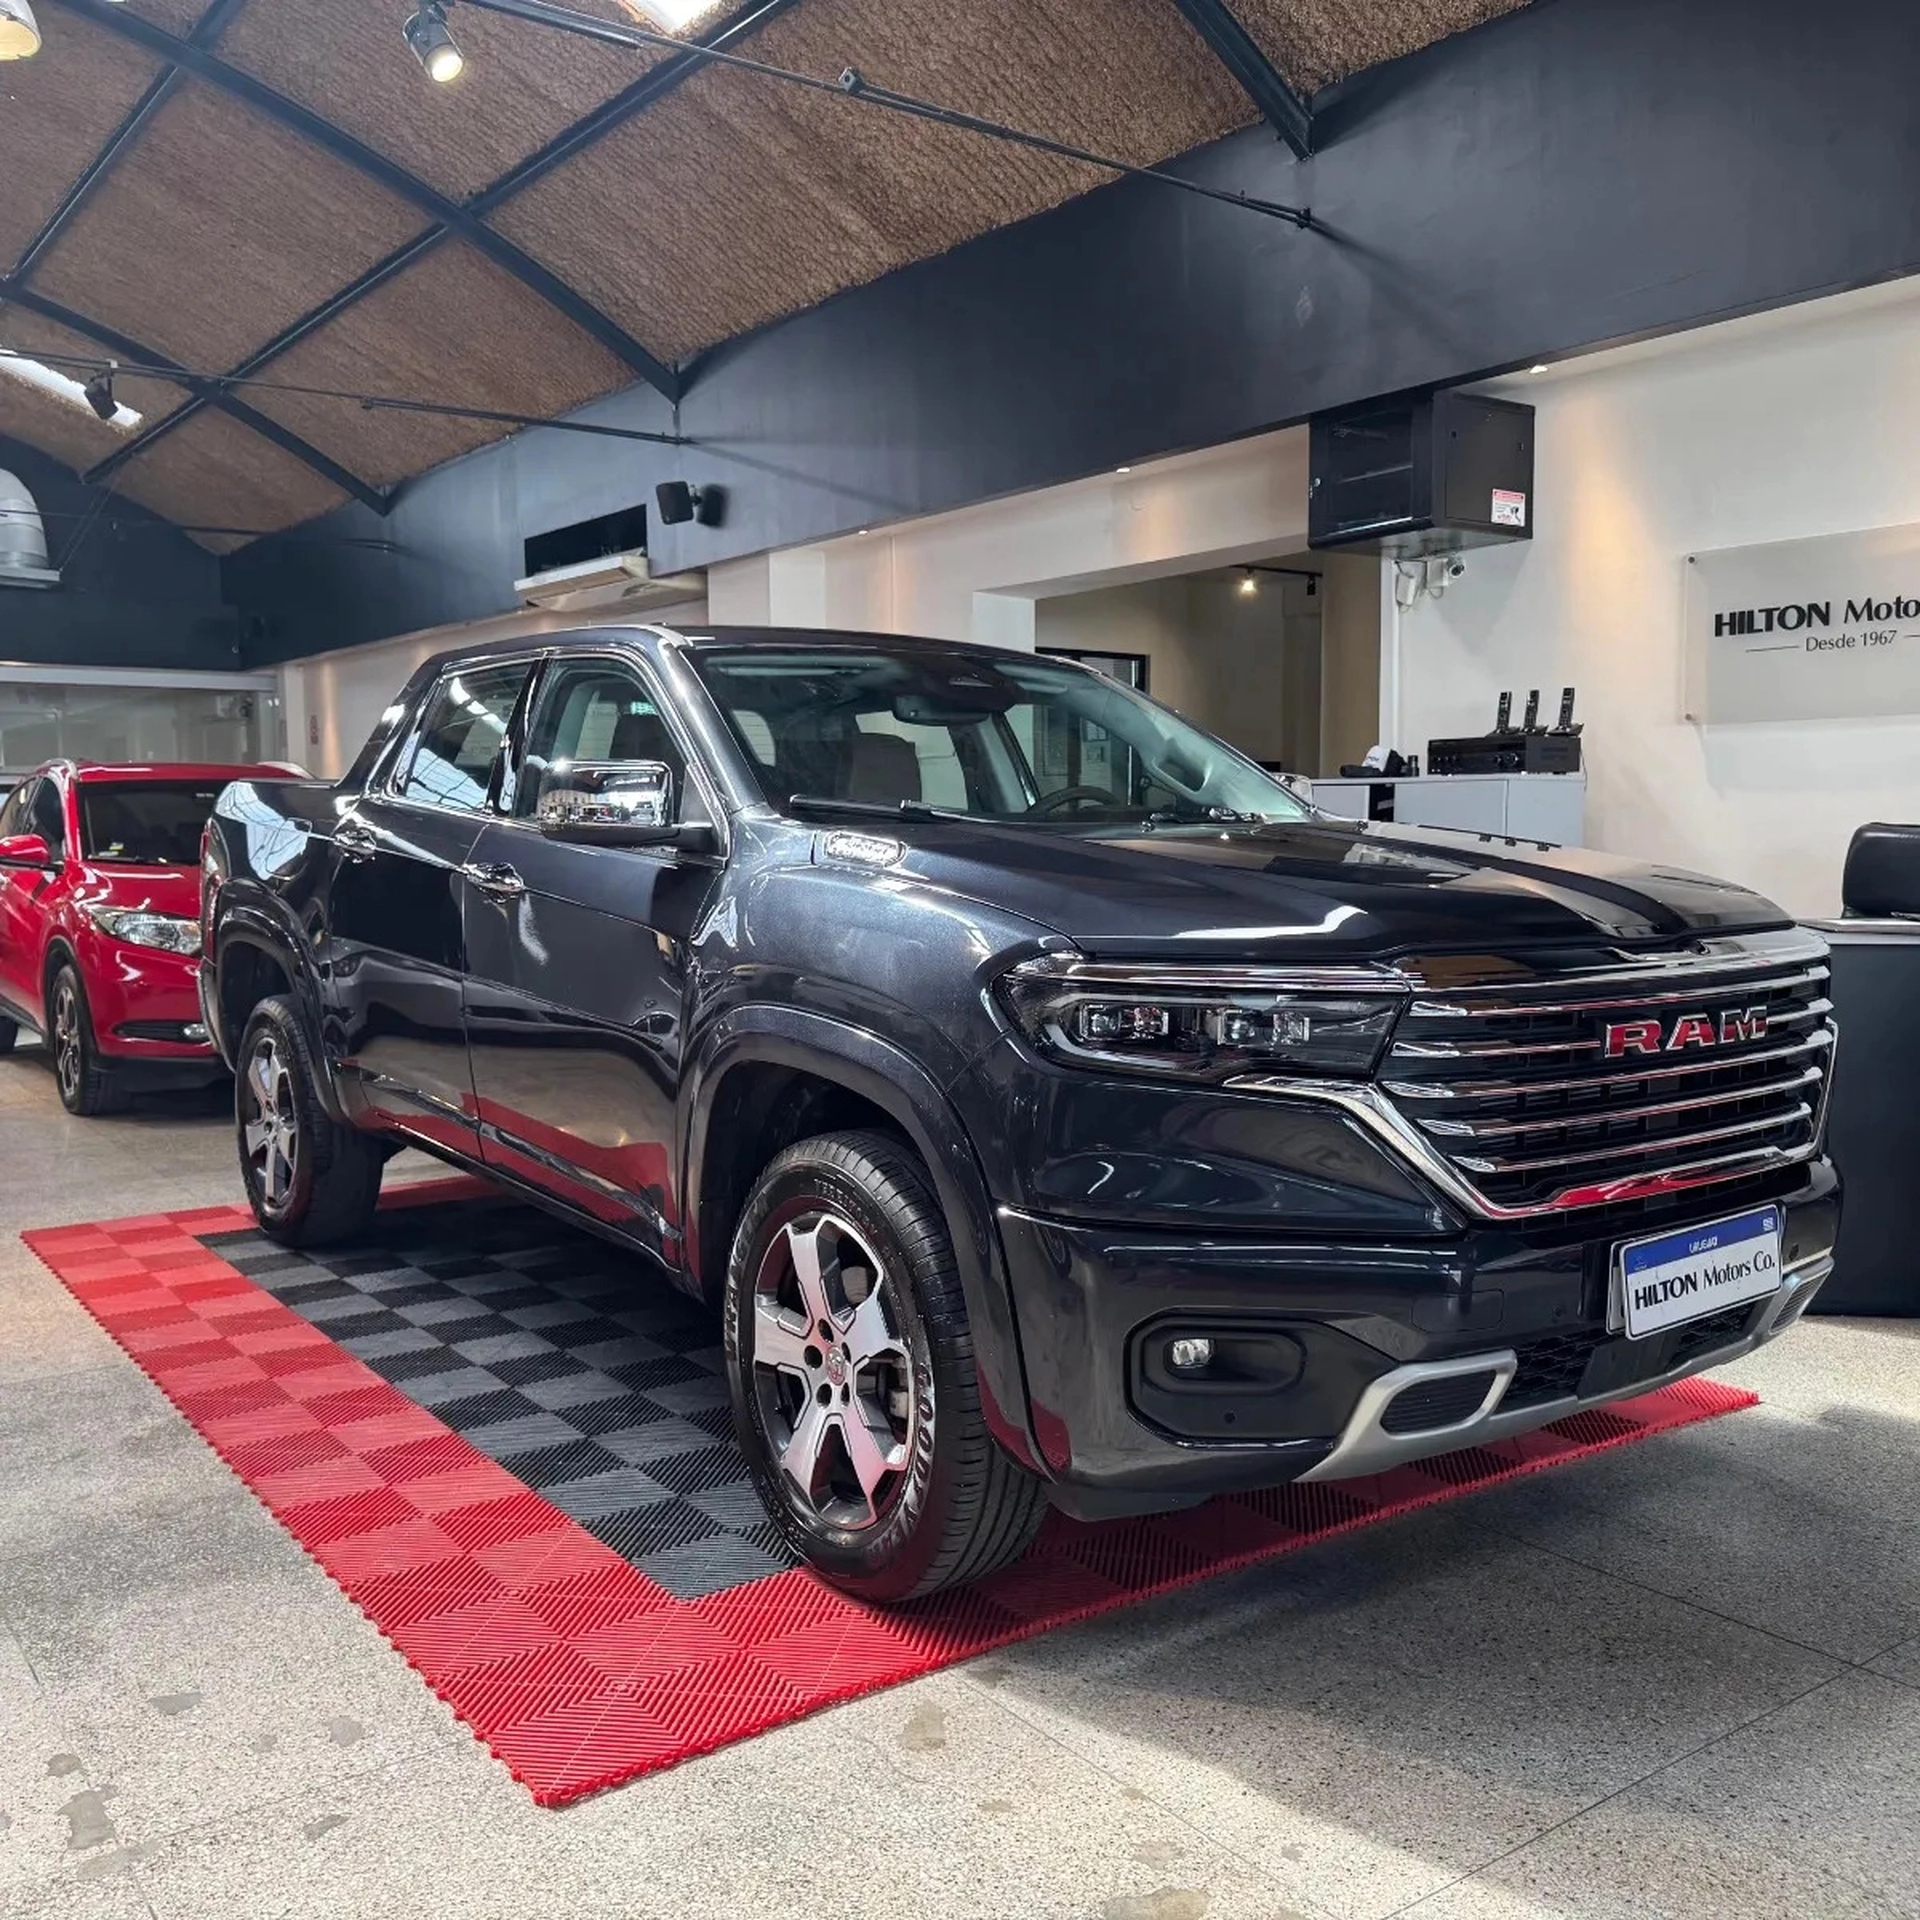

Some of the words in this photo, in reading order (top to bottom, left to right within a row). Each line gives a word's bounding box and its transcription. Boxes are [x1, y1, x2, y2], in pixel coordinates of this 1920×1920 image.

[1714, 601, 1830, 637] HILTON
[1805, 633, 1855, 651] Desde
[1860, 630, 1897, 647] 1967
[1604, 1006, 1767, 1058] RAM
[1634, 1272, 1698, 1310] HILTON
[1703, 1262, 1751, 1290] Motors
[1753, 1251, 1775, 1272] Co.
